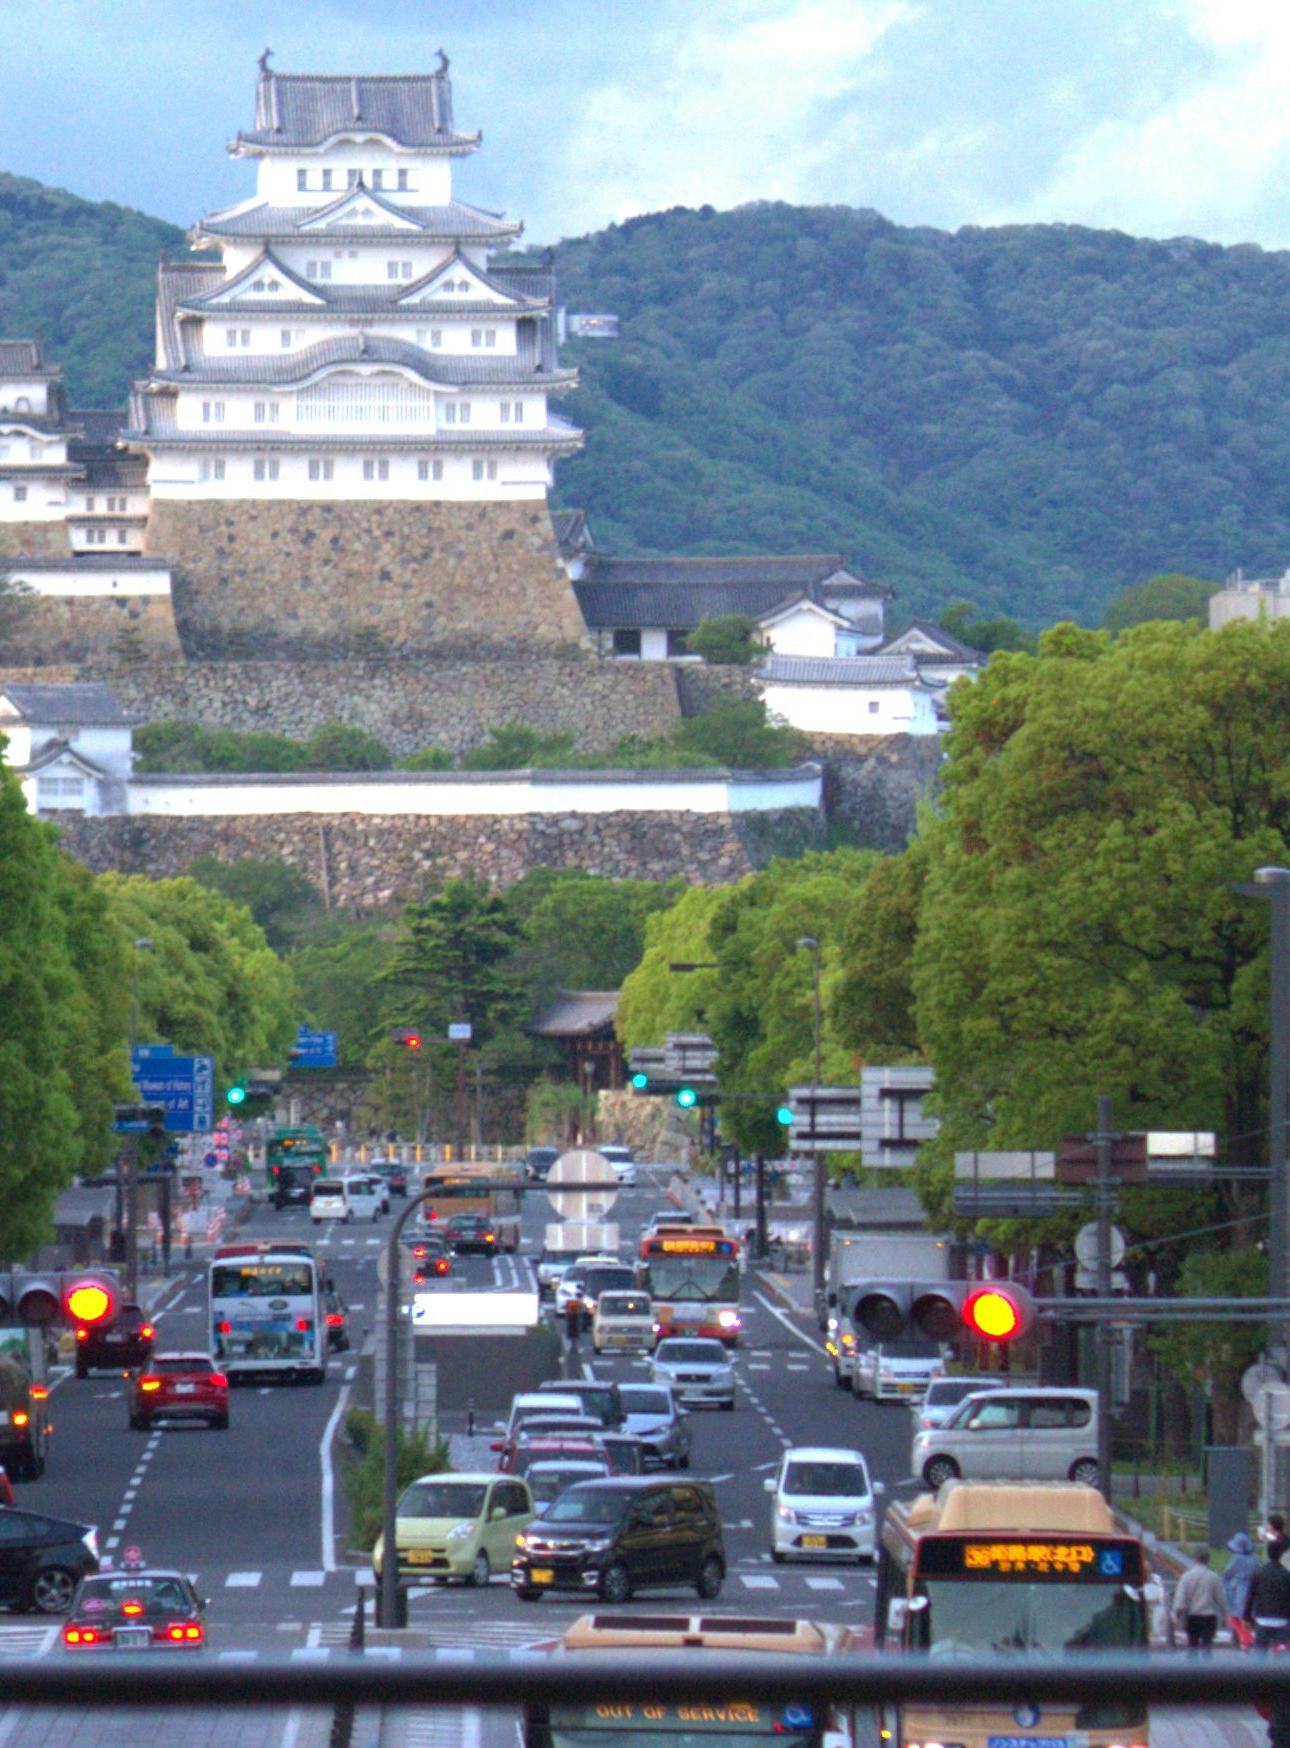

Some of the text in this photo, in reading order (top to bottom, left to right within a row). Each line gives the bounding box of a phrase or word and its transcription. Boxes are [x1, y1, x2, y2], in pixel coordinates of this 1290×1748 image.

[964, 1545, 991, 1568] 36
[596, 1704, 761, 1722] OUT OF SERVICE
